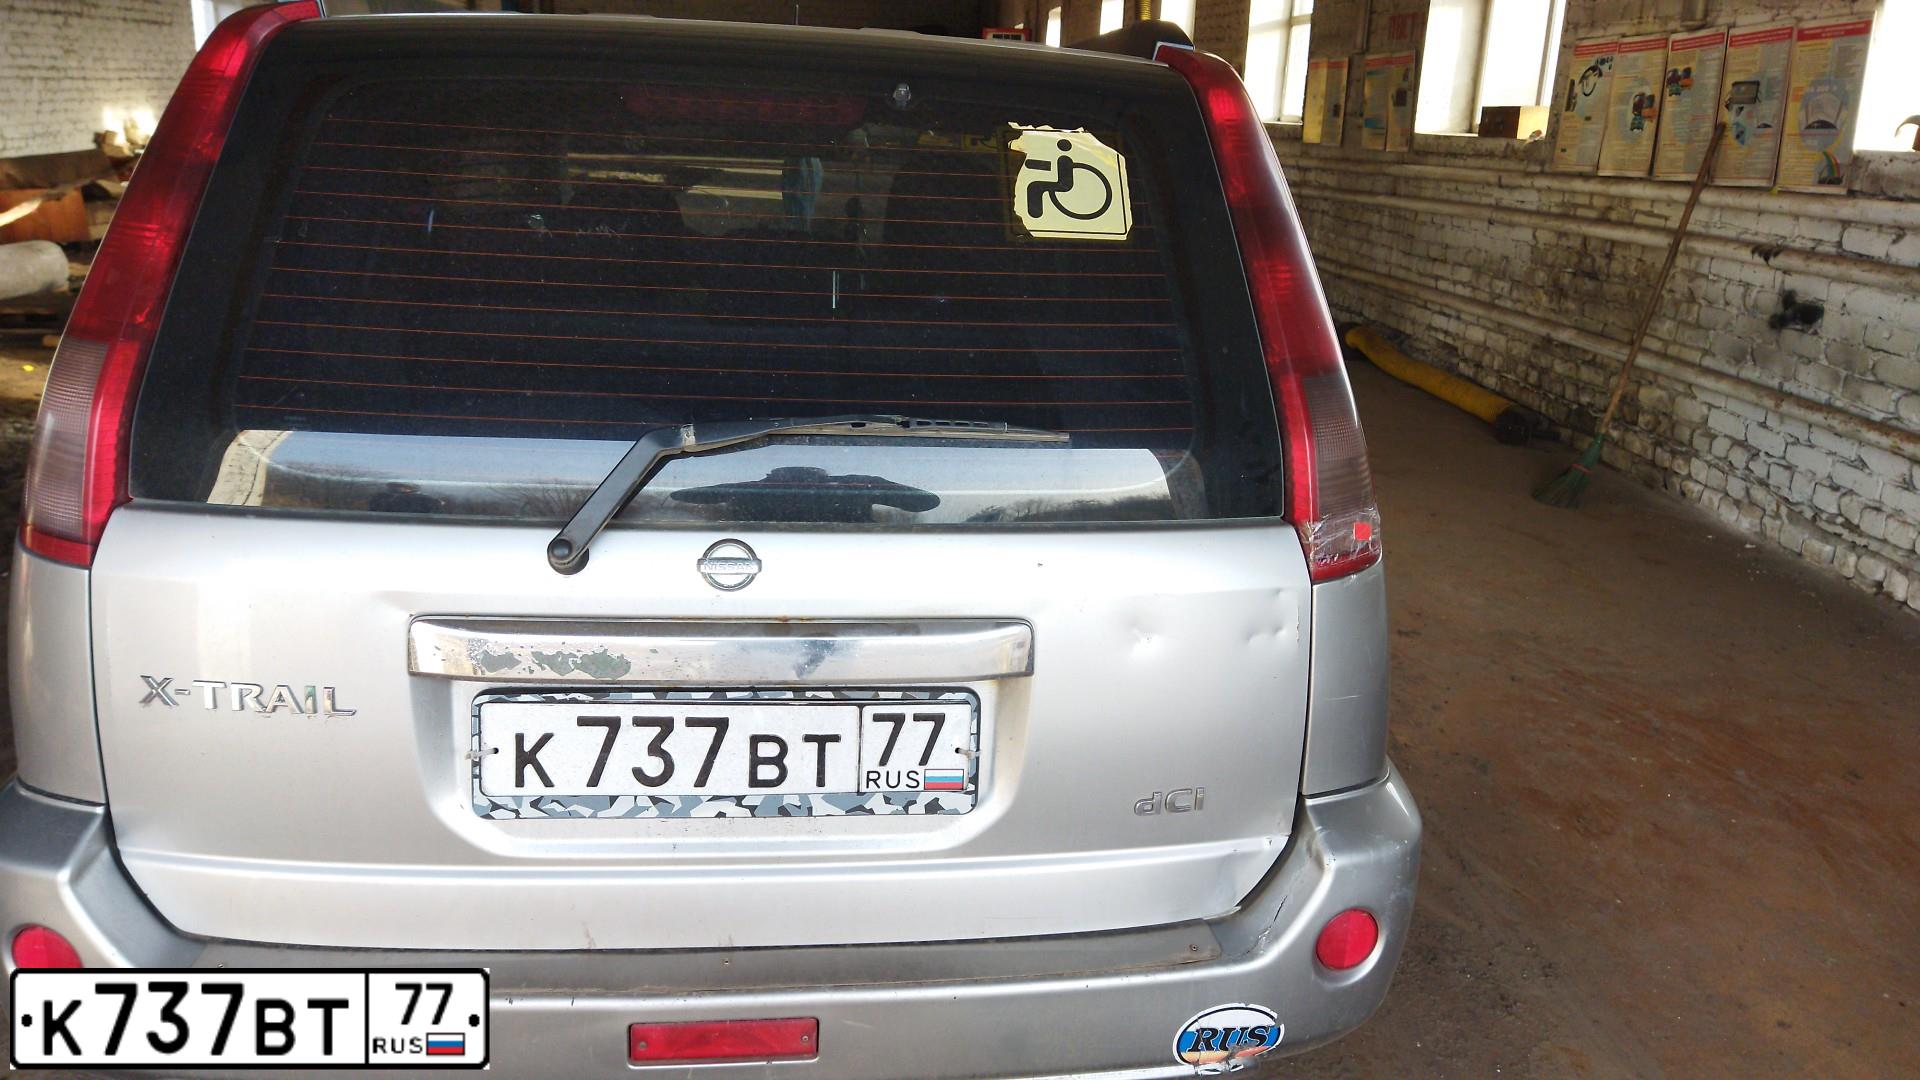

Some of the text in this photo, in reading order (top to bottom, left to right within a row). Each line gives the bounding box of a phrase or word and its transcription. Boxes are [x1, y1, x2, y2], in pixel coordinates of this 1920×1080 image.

[139, 674, 358, 717] X-TRAIL
[871, 712, 946, 767] 77
[865, 769, 921, 790] RUS
[1186, 1024, 1270, 1053] RUS
